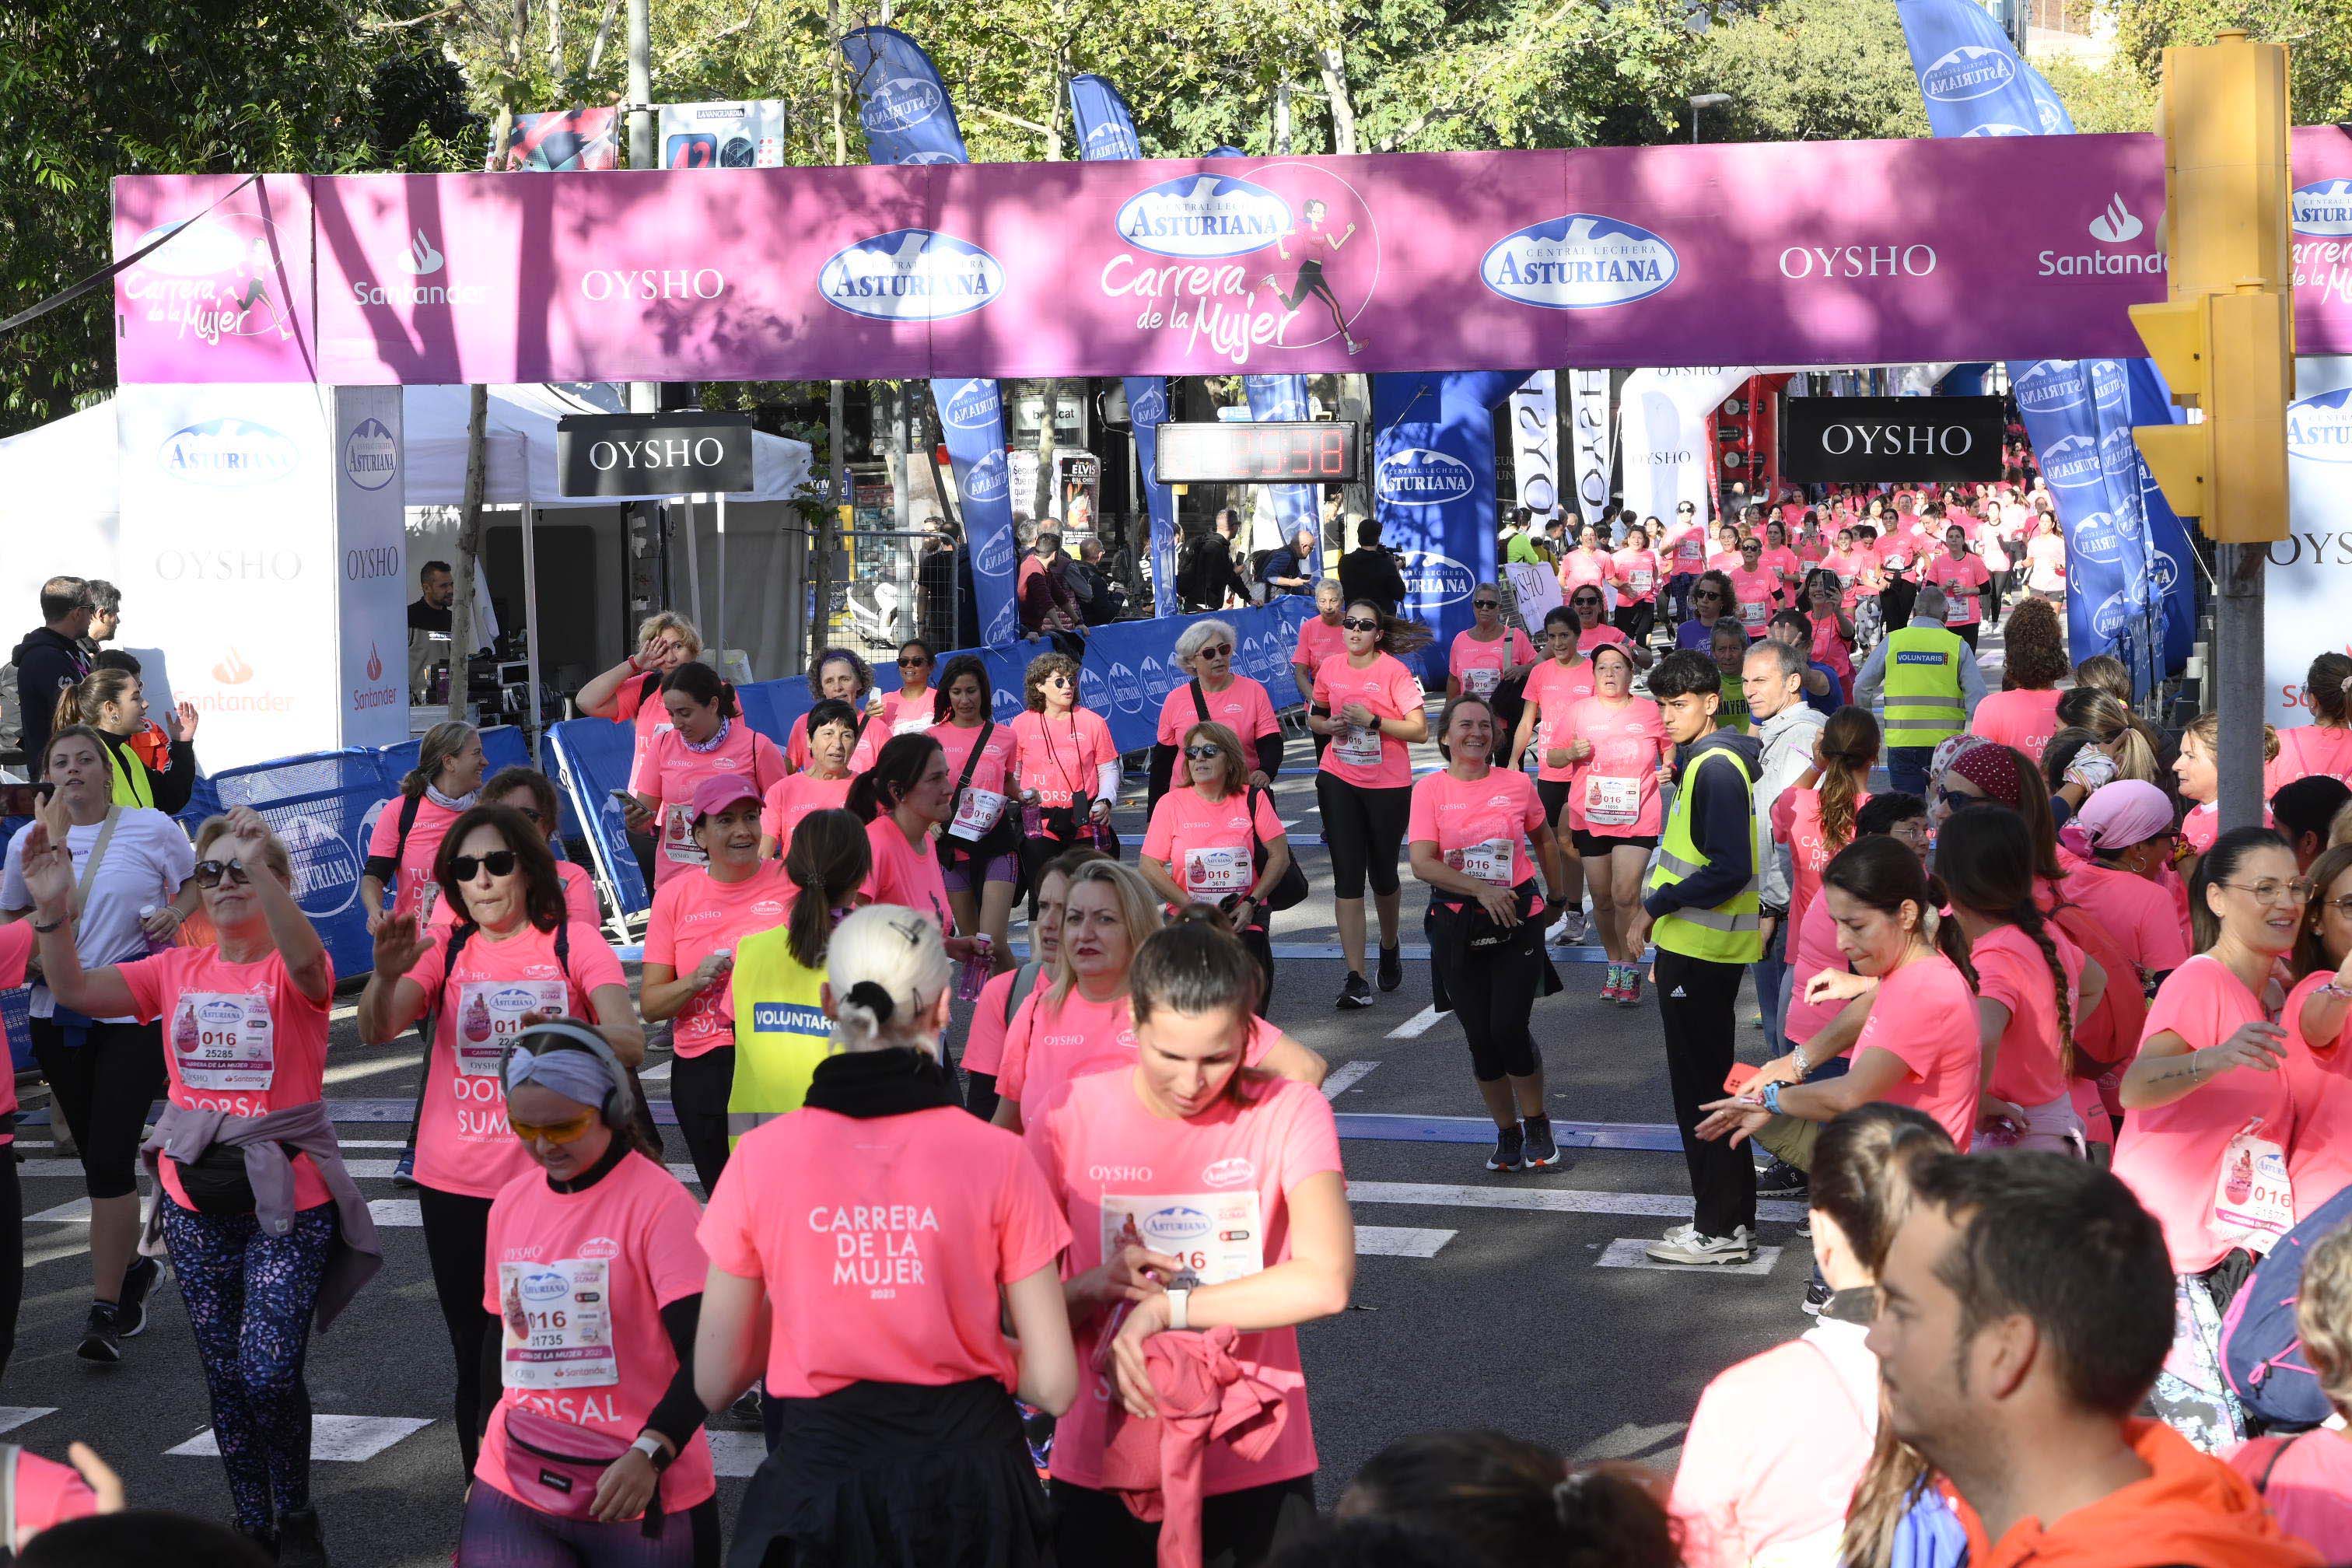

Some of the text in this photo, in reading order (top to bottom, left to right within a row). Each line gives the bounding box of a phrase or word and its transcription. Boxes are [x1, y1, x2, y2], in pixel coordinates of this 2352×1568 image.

[1129, 205, 1278, 237] ASTURIANA
[1526, 245, 1657, 257] CENTRAL LECHERA
[1496, 250, 1663, 287] ASTURIANA
[1779, 244, 1937, 279] OYSHO
[2039, 250, 2168, 277] Santand
[581, 269, 724, 301] OYSHO
[833, 262, 990, 298] ASTURIANA
[1101, 254, 1247, 297] Carrera
[124, 271, 216, 302] Carrera
[178, 296, 251, 345] Mujer
[1136, 291, 1300, 365] de la Mujer
[1821, 425, 1973, 457] OYSHO
[349, 453, 394, 473] ASTURIANA
[589, 437, 725, 471] OYSHO
[1073, 464, 1096, 475] ELVIS
[1378, 473, 1467, 492] ASTURIANA
[2266, 532, 2352, 566] OYS
[155, 548, 302, 582] OYSHO
[347, 545, 398, 581] OYSHO
[1401, 575, 1467, 593] URIANA
[1897, 653, 1943, 663] VOLUNTARIS
[173, 690, 296, 713] Santander
[353, 688, 398, 712] Santander
[1349, 736, 1363, 745] 016
[667, 759, 694, 768] OYSHO
[1033, 773, 1045, 786] TU
[1038, 789, 1074, 802] ORSA
[974, 810, 992, 821] 016
[1466, 859, 1489, 870] 016
[305, 857, 356, 892] URIANA
[1208, 870, 1230, 879] 016
[684, 910, 722, 923] OYSHO
[493, 998, 534, 1007] ASTURIANA
[495, 1020, 527, 1034] 01
[201, 1031, 237, 1046] 016
[1044, 1034, 1084, 1046] OYSHO
[205, 1049, 234, 1059] 25285
[457, 1109, 516, 1136] SUM
[1089, 1165, 1153, 1183] OYSHO
[2254, 1186, 2291, 1208] 016
[809, 1205, 940, 1232] CARRERA
[1150, 1218, 1207, 1232] ASTURIANA
[505, 1245, 544, 1259] OYSHO
[837, 1233, 919, 1258] DE LA
[1174, 1251, 1206, 1270] 16
[833, 1258, 925, 1286] MUJER
[529, 1311, 566, 1328] 016
[565, 1367, 607, 1377] Santander
